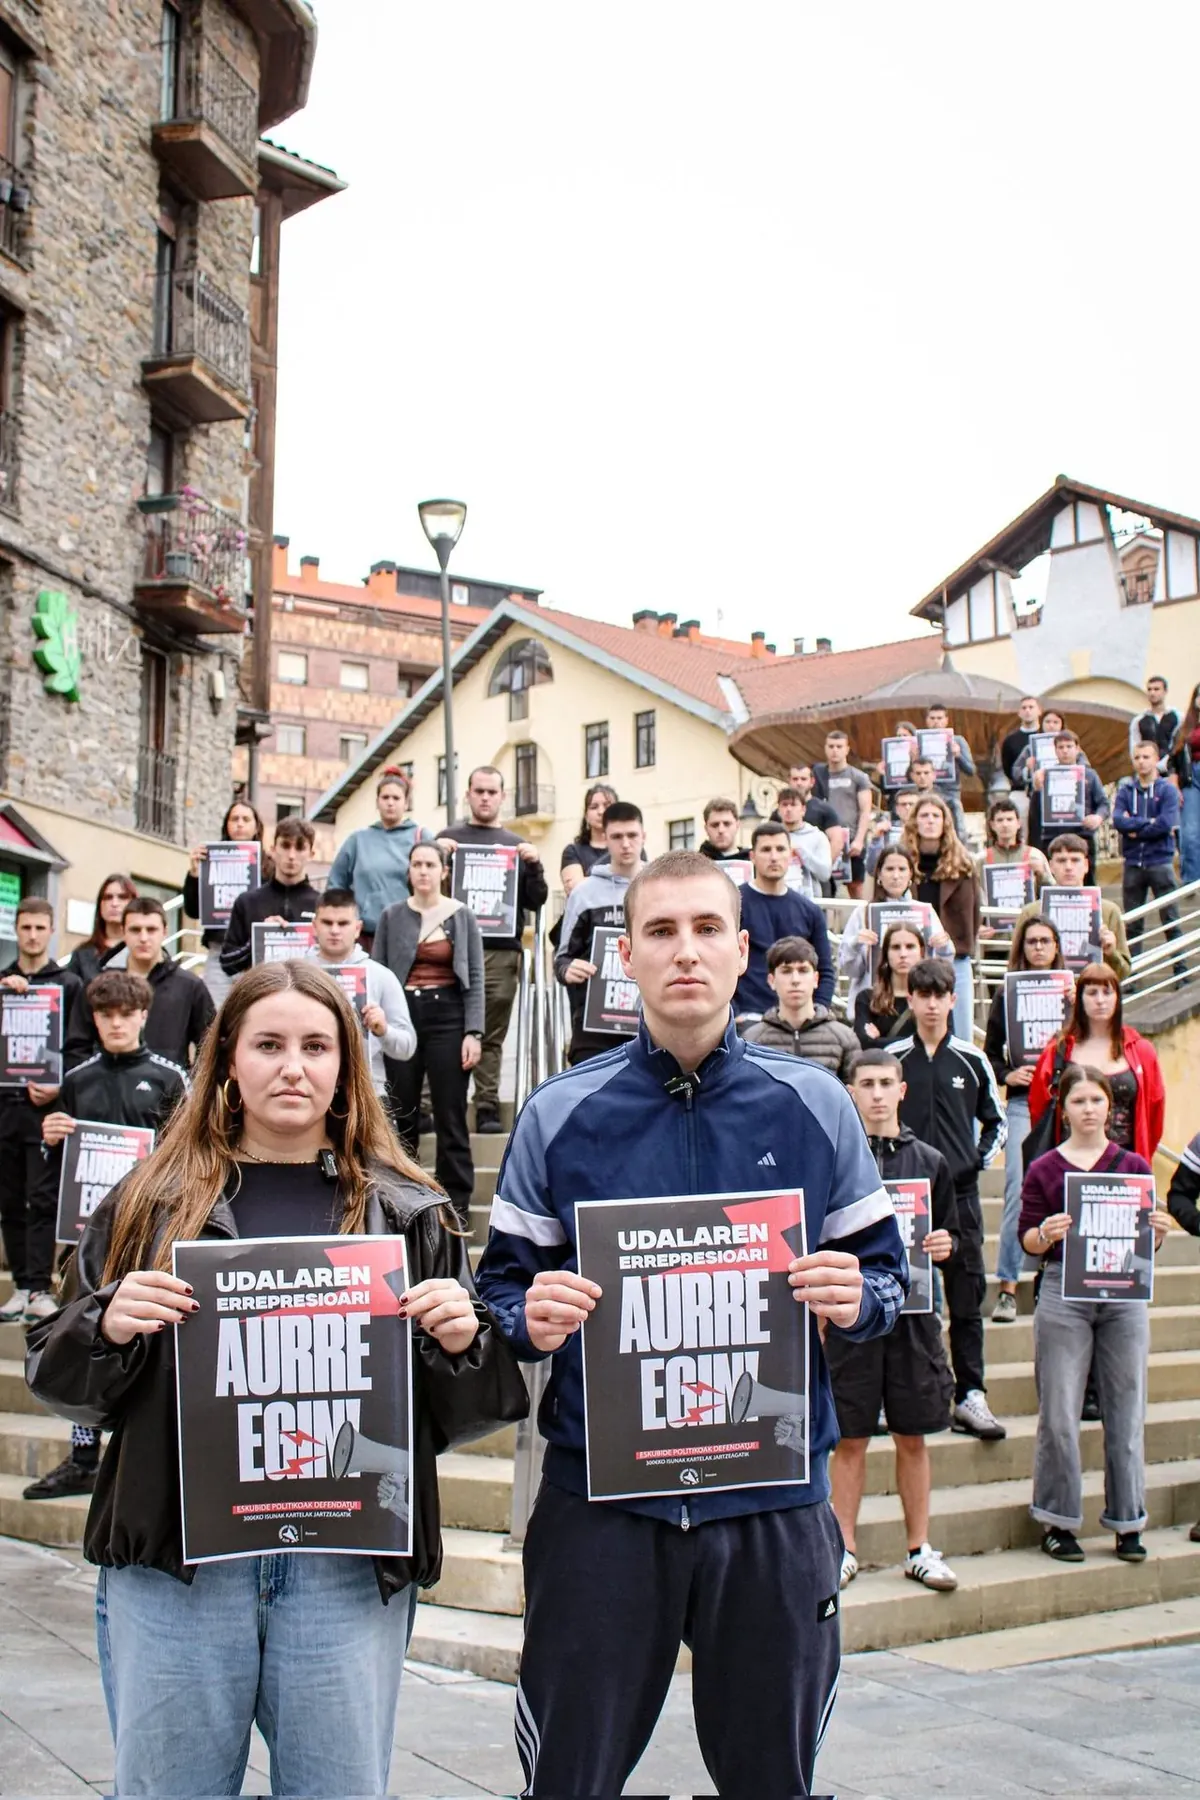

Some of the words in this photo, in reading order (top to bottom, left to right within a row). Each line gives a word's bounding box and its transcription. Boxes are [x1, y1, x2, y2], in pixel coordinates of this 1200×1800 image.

[1079, 1203, 1141, 1238] AURRE
[618, 1222, 769, 1251] UDALAREN
[619, 1248, 768, 1270] ERREPRESIOARI
[215, 1265, 371, 1293] UDALAREN
[216, 1291, 370, 1312] ERREPRESIOARI
[619, 1268, 771, 1354] AURRE
[215, 1312, 372, 1397] AURRE
[640, 1351, 760, 1431] EGIN!
[237, 1399, 361, 1482] EGIN!
[640, 1449, 673, 1459] ESKUBIDE
[673, 1446, 713, 1456] POLITIKOAK
[237, 1504, 270, 1513] ESKUBIDE
[271, 1502, 313, 1511] POLITIKOAK
